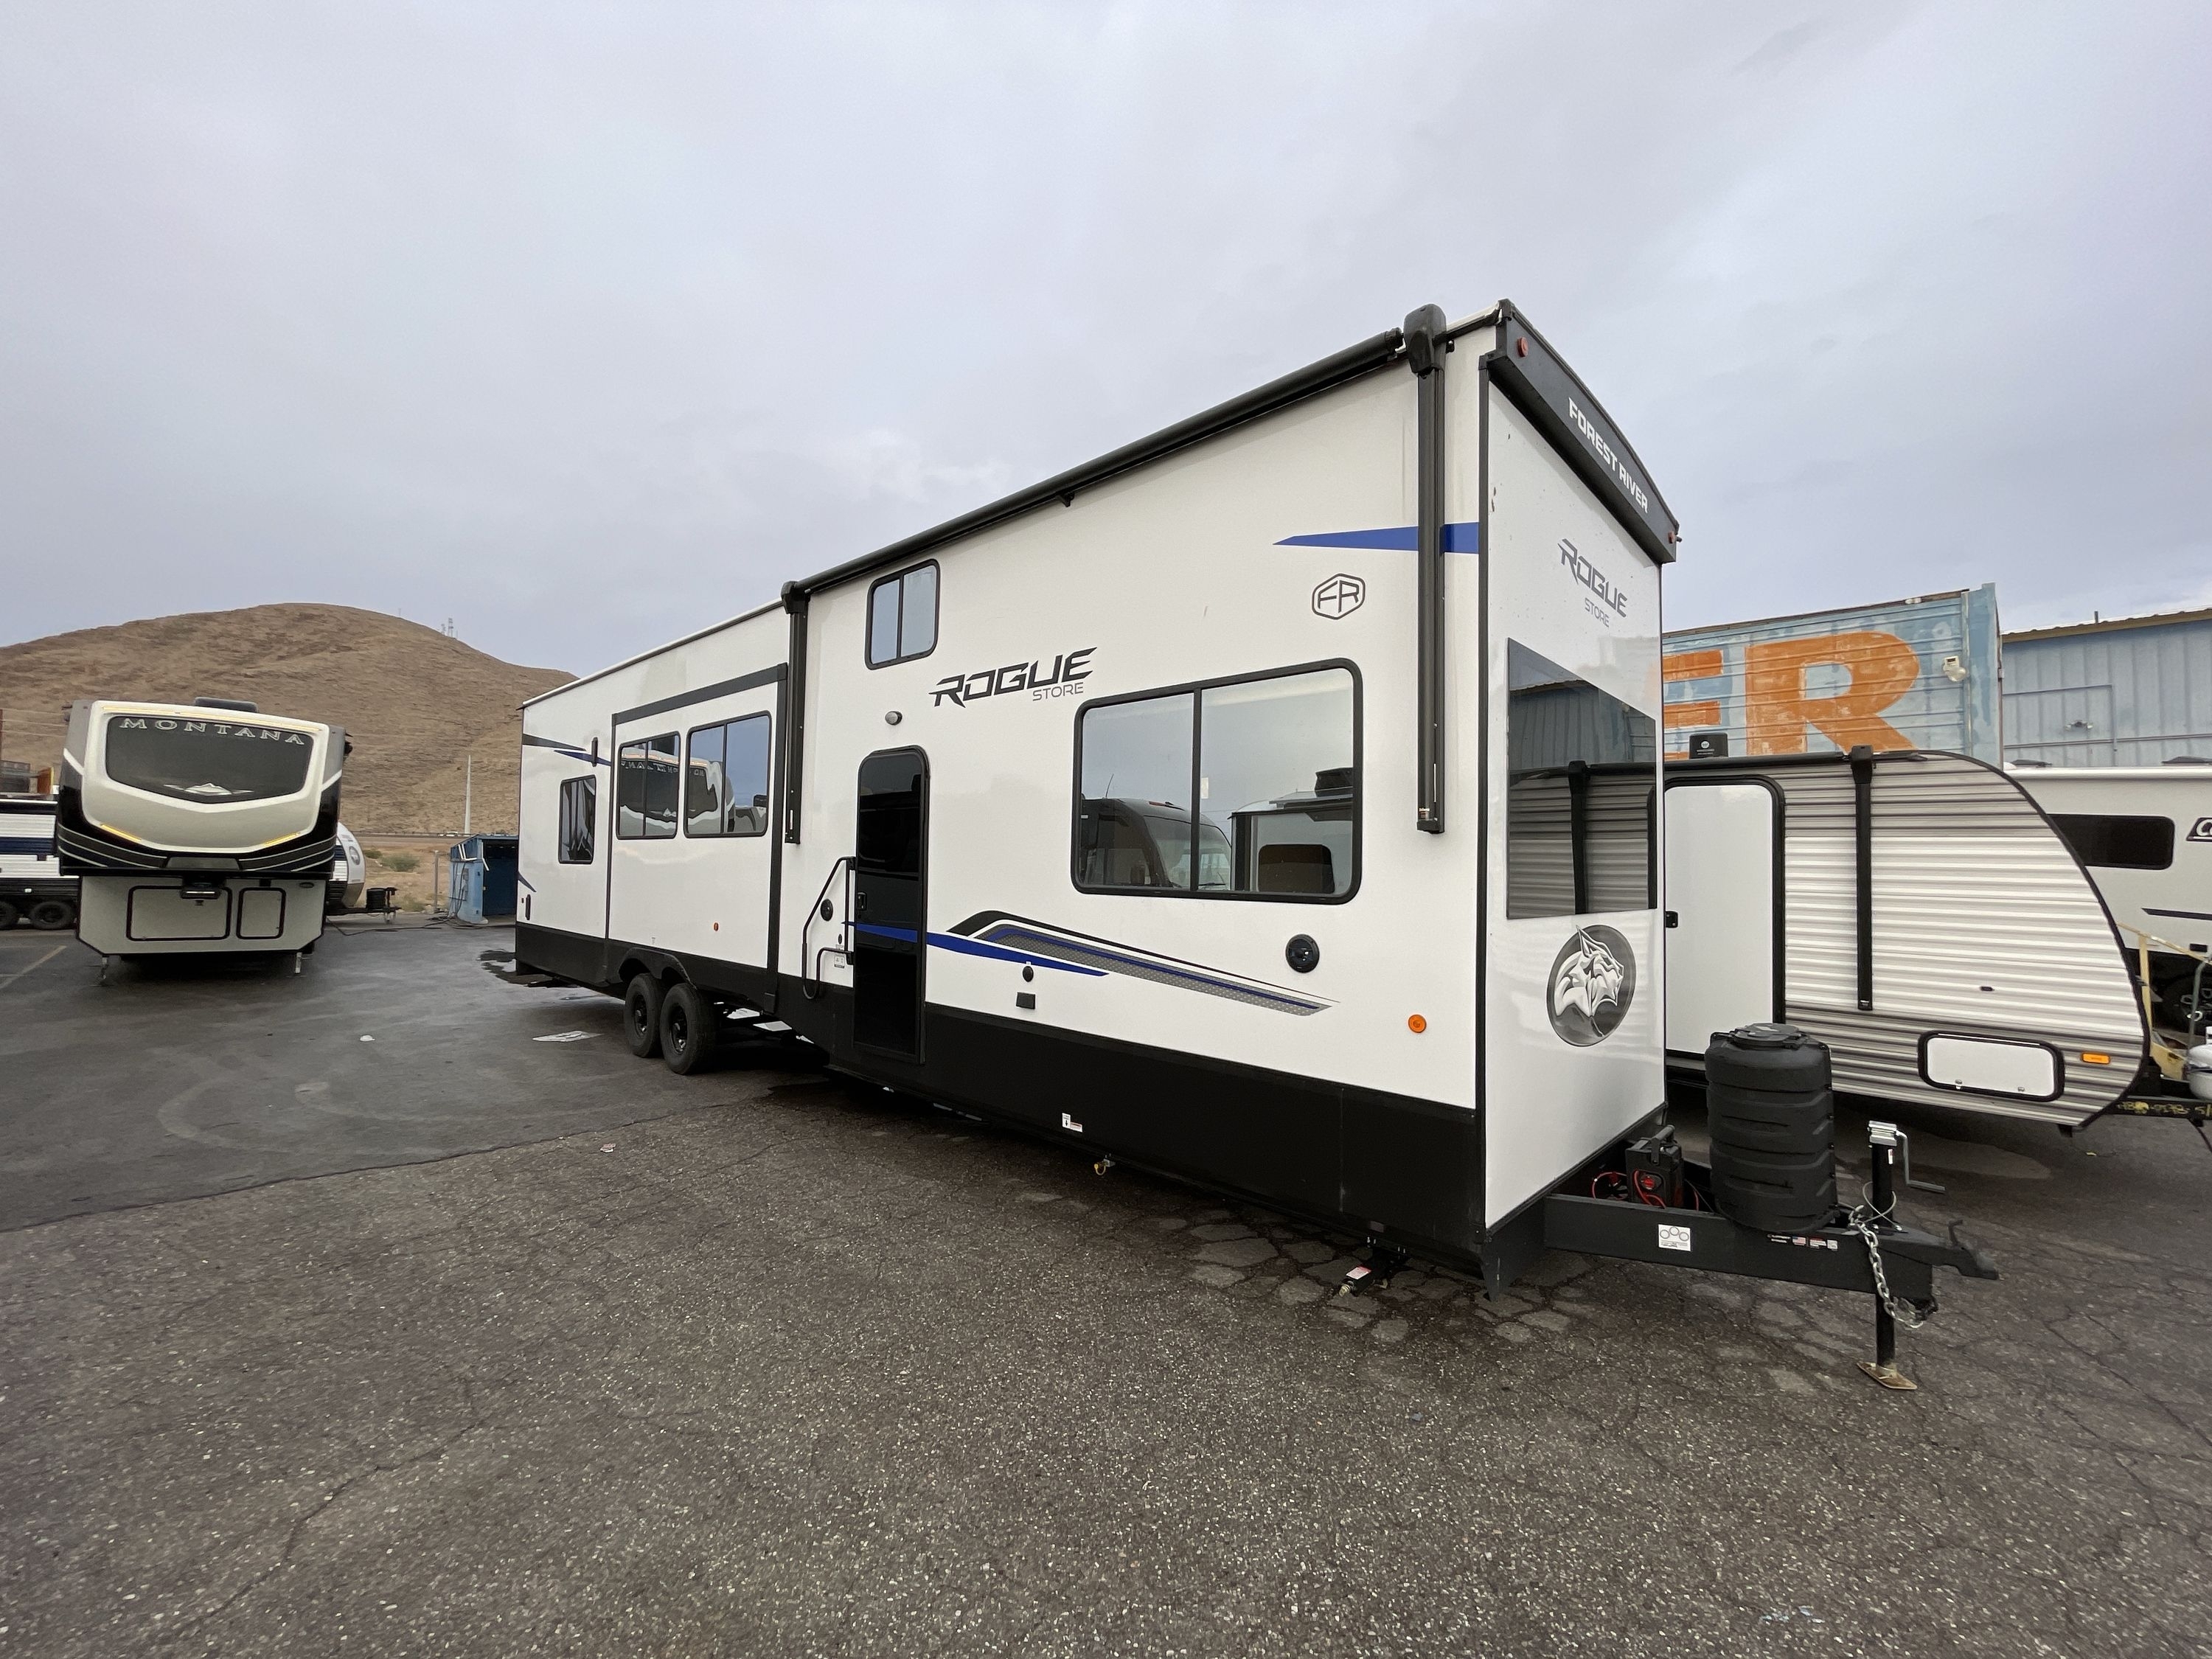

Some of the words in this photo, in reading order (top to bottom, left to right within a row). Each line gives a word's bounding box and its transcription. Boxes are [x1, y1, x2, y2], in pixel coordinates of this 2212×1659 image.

[1568, 397, 1618, 472] FOREST
[1618, 462, 1648, 514] RIVER
[1557, 538, 1627, 618] ROGUE
[1584, 597, 1610, 628] STORE
[928, 647, 1098, 708] ROGUE
[1032, 681, 1084, 701] STORE
[119, 717, 305, 745] MONTANA
